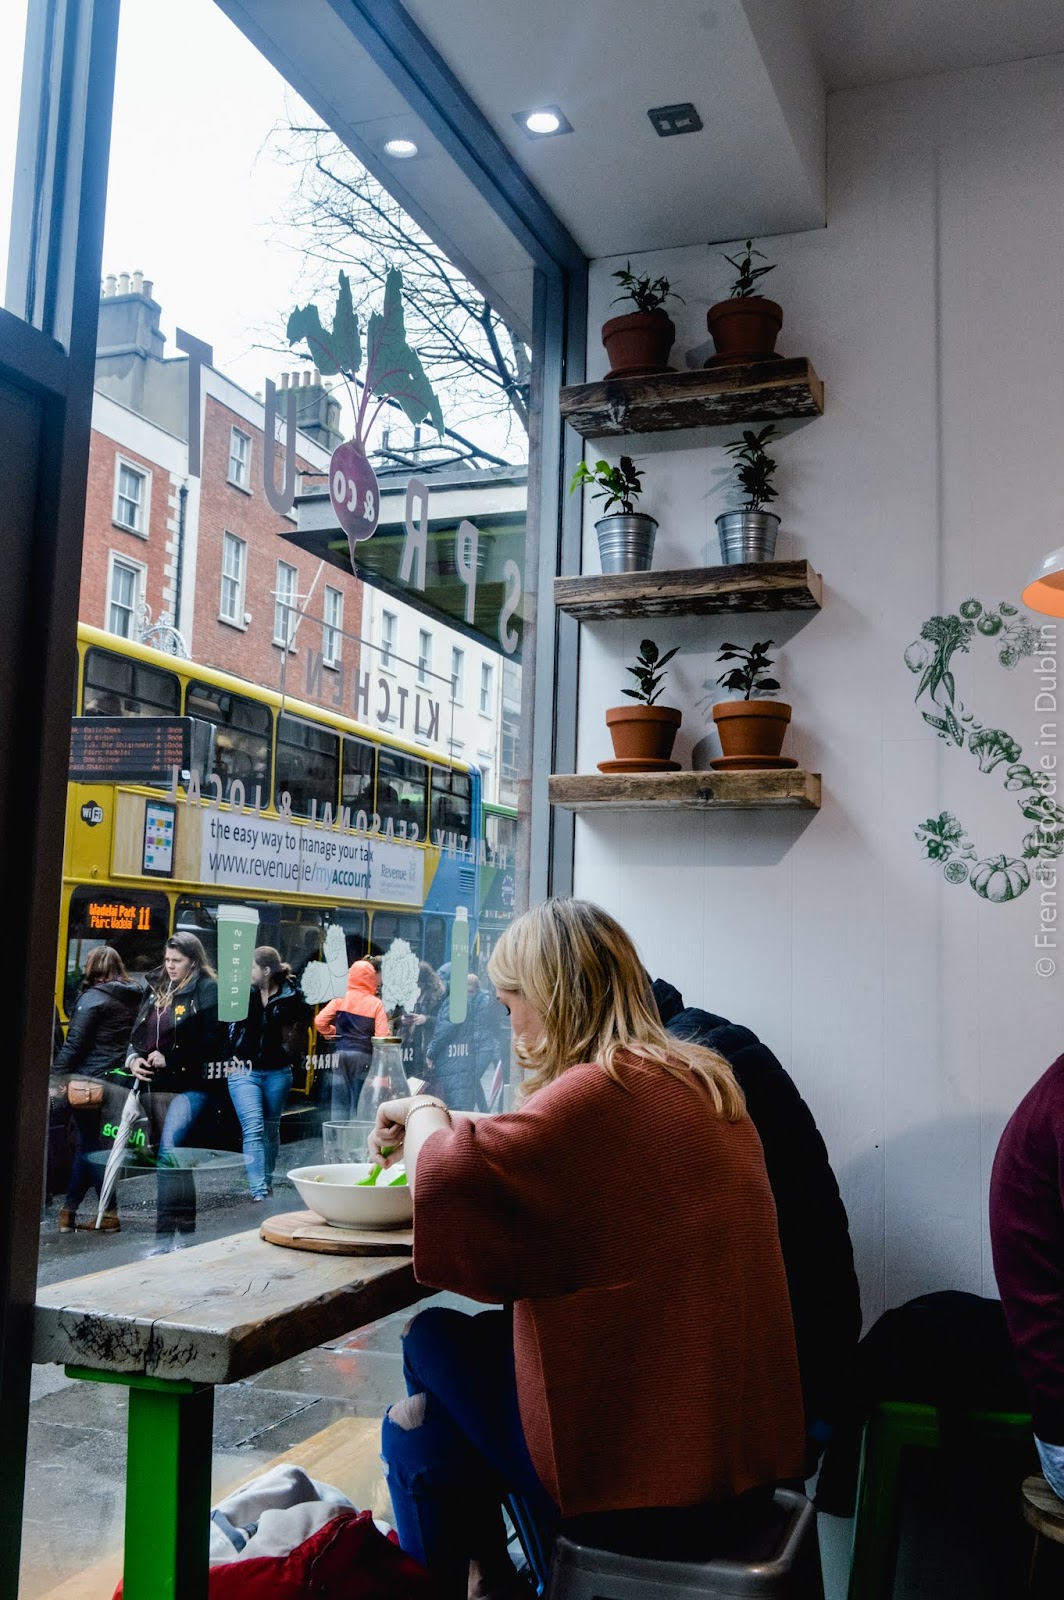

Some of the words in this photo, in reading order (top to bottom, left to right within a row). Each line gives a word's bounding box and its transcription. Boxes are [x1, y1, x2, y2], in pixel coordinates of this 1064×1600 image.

[210, 818, 230, 840] the
[233, 826, 258, 850] easy
[261, 831, 283, 854] way
[285, 831, 296, 850] to
[298, 837, 337, 861] manage
[338, 843, 358, 862] your
[360, 844, 374, 862] tax
[381, 863, 408, 880] Revenue
[119, 904, 136, 918] Park
[137, 906, 150, 930] 11
